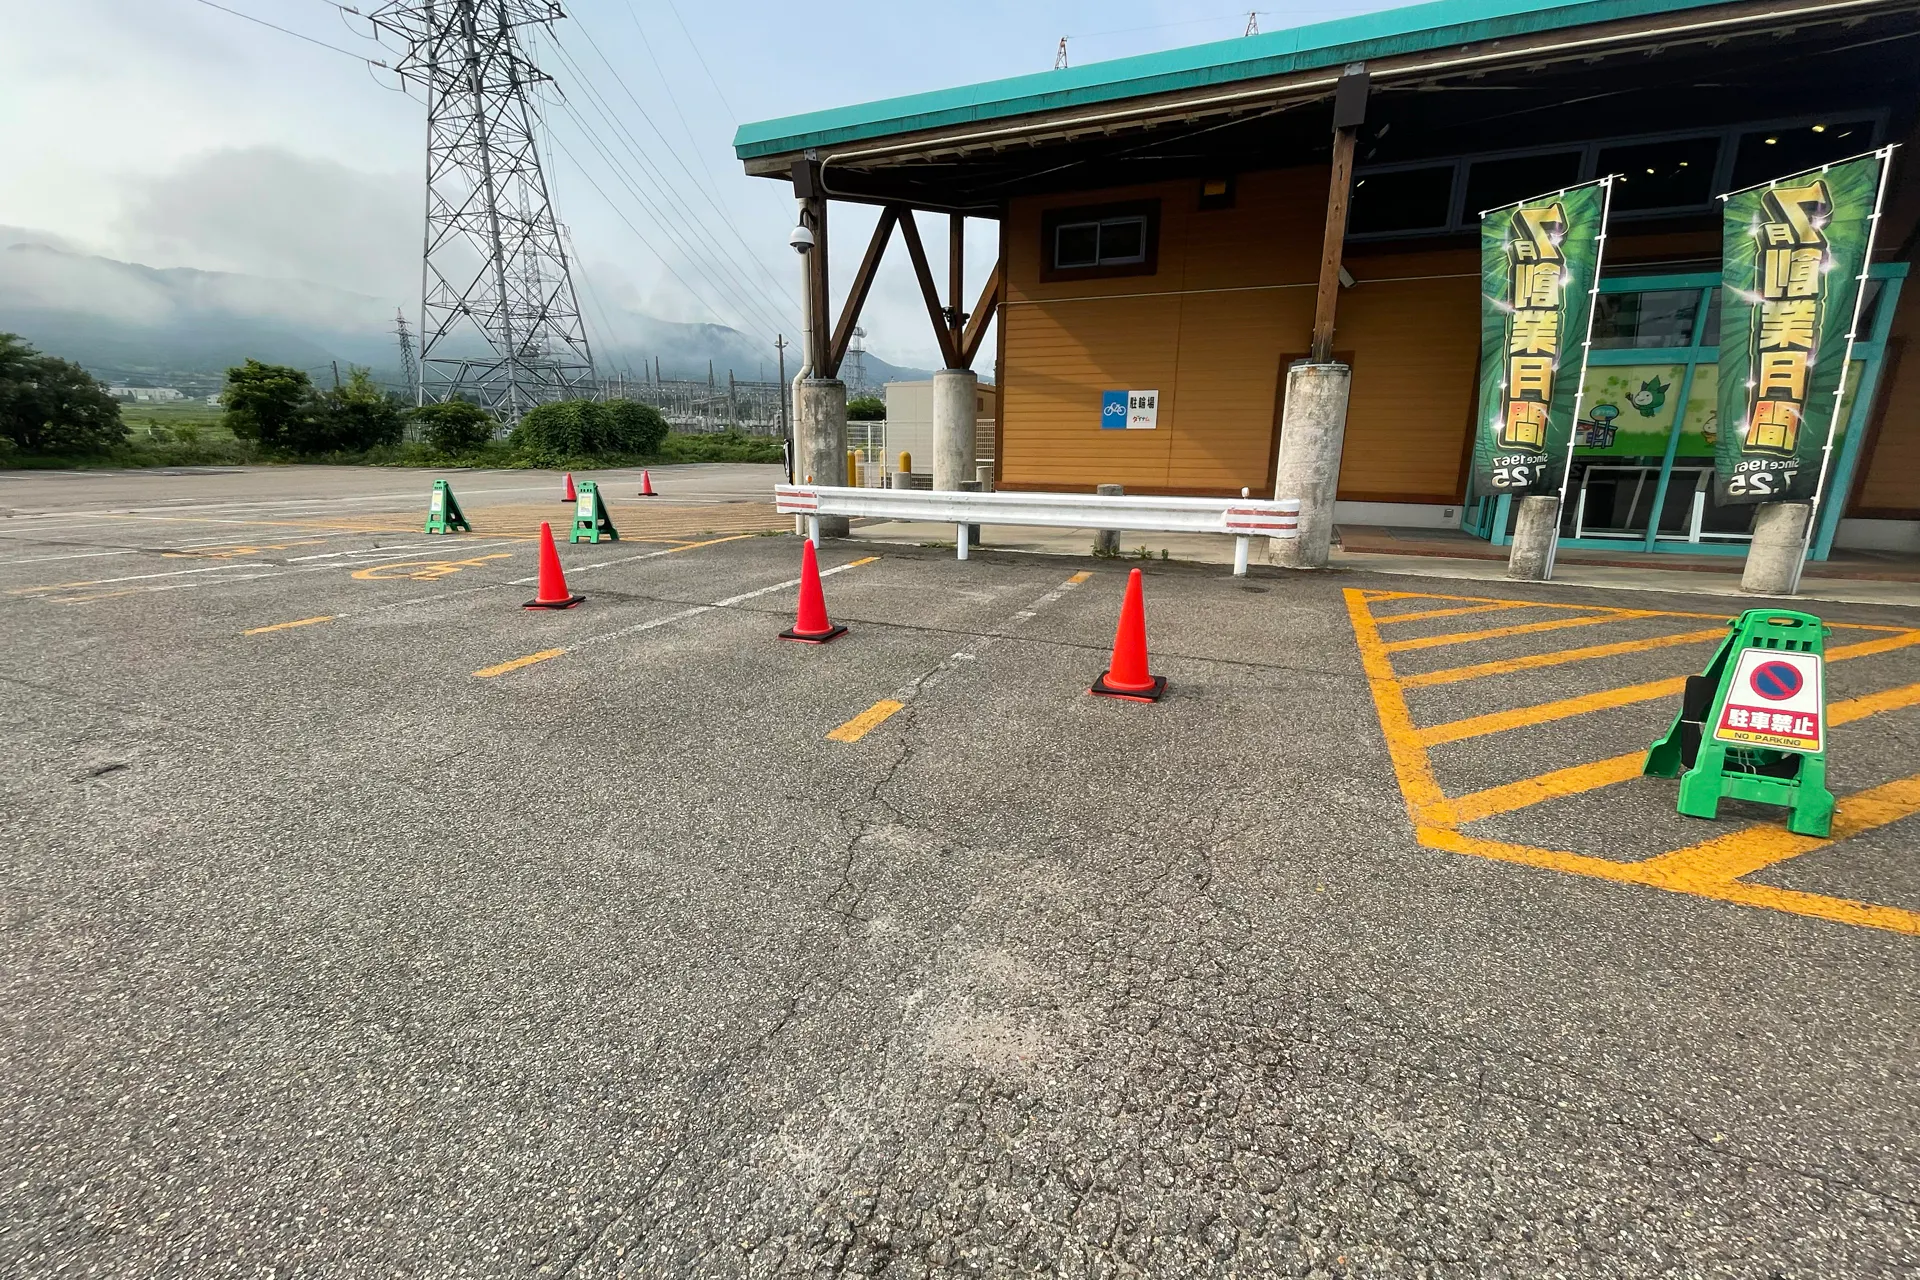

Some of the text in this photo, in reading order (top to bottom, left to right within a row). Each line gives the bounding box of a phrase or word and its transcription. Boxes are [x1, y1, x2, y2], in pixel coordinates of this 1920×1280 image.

[1130, 396, 1155, 409] 駐輪場
[1727, 708, 1814, 736] 駐車禁止
[1734, 731, 1802, 747] NO PARKING
